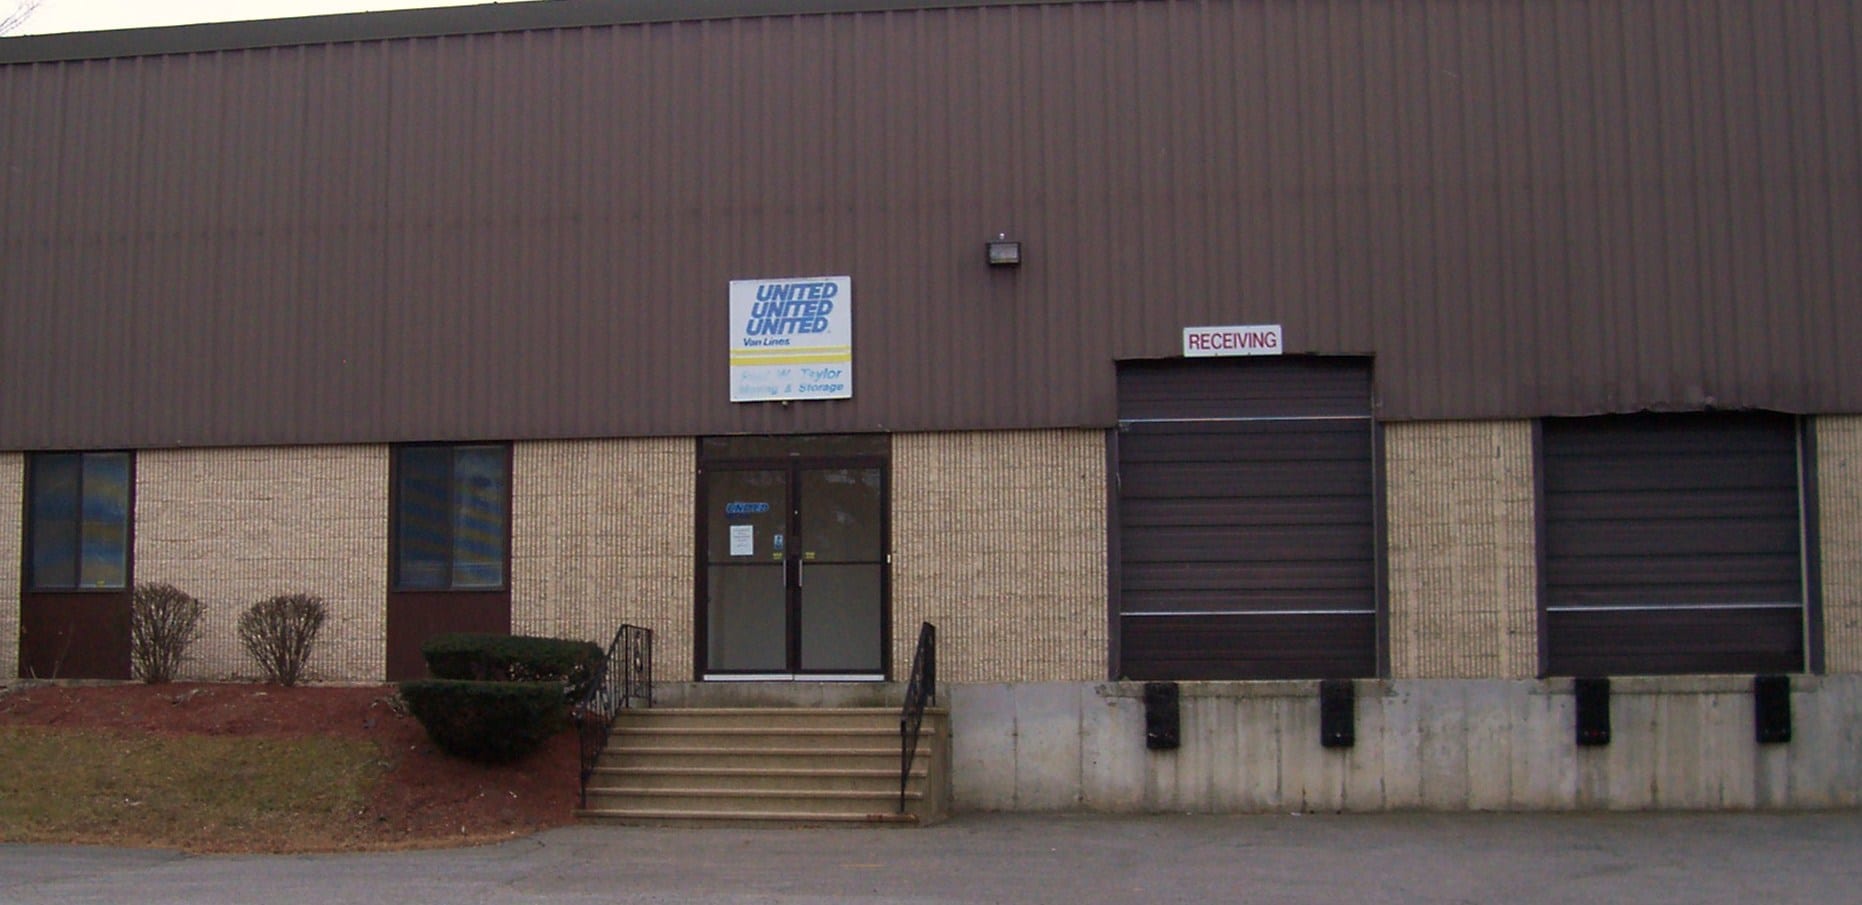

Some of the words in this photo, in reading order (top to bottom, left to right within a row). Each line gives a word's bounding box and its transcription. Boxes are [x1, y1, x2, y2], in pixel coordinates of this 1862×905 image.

[756, 282, 838, 301] UNITED
[751, 300, 833, 318] UNITED
[746, 317, 828, 335] UNITED
[743, 338, 762, 347] Van
[763, 337, 790, 347] Lines
[1189, 332, 1277, 350] RECEIVING
[801, 368, 843, 382] Taylor
[798, 382, 844, 394] Storage
